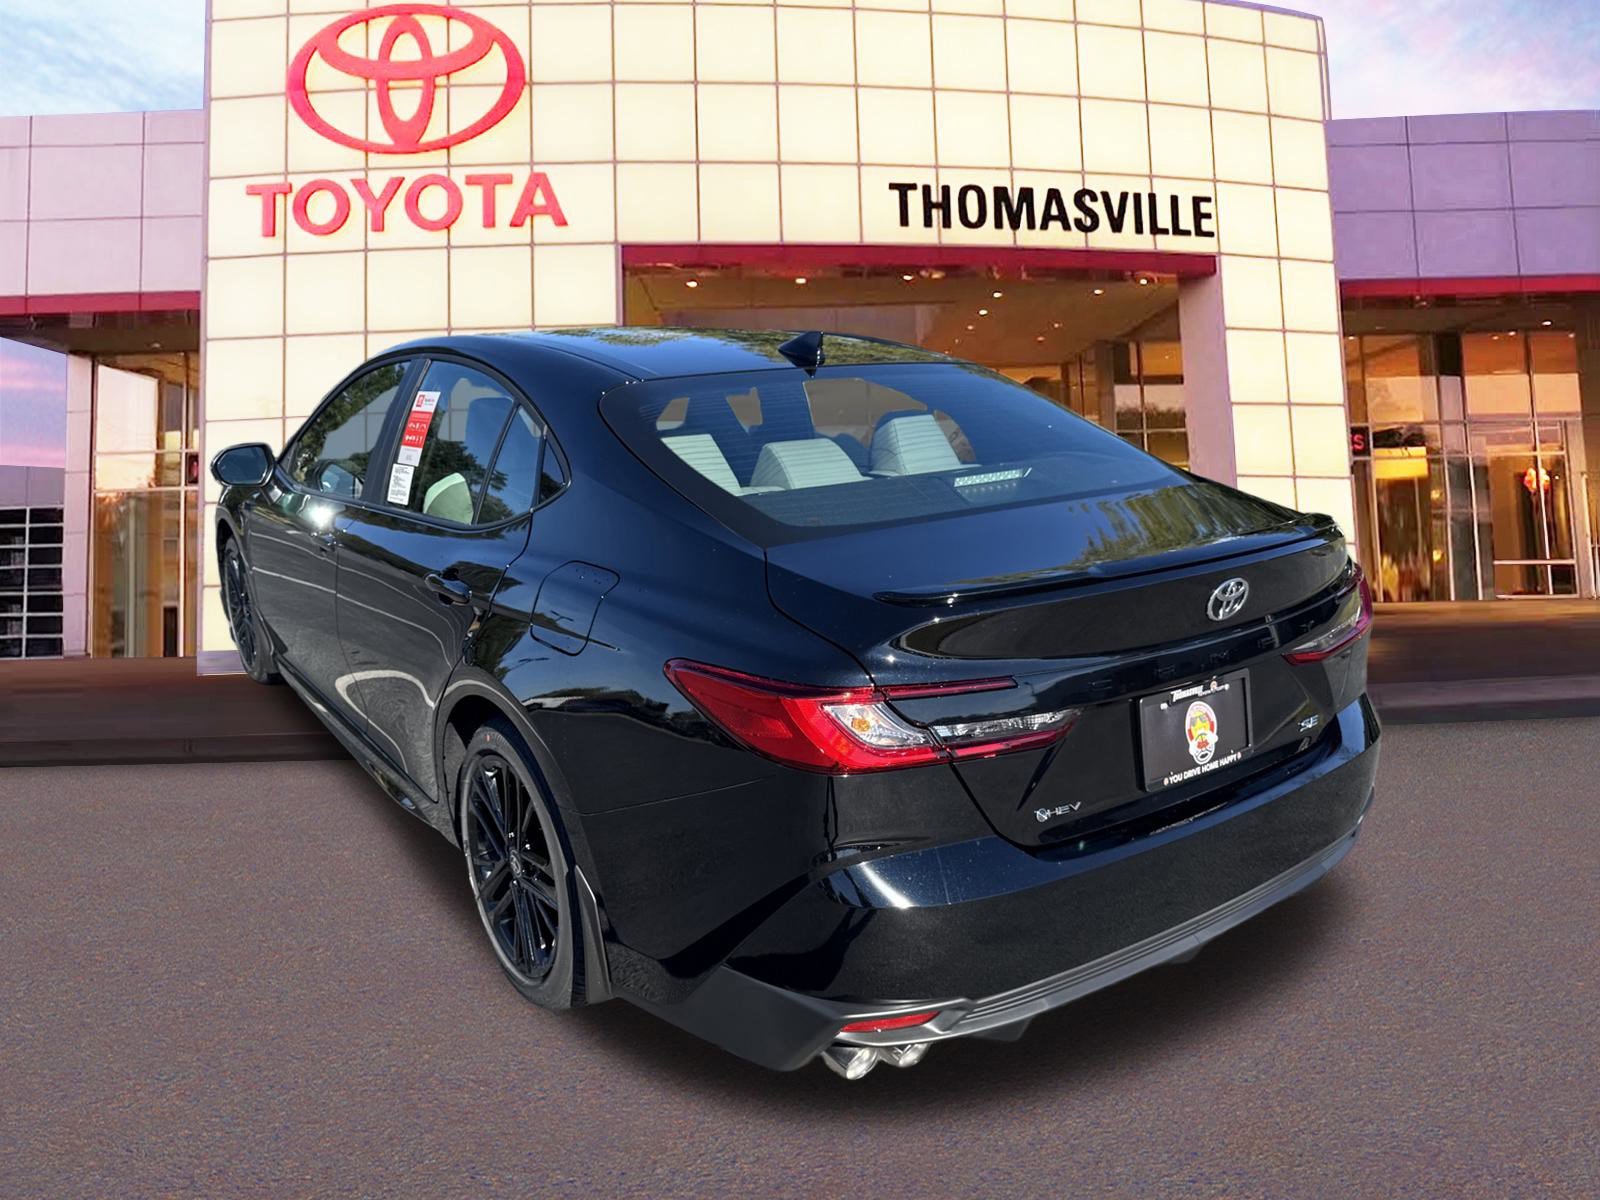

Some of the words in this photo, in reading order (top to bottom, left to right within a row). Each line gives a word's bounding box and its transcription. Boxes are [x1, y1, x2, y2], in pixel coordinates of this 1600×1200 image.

[246, 172, 568, 237] TOYOTA
[889, 183, 1215, 237] THOMASVILLE
[1169, 772, 1183, 784] YOU
[1183, 767, 1201, 780] DRIVE
[1201, 760, 1219, 773] HOME
[1219, 753, 1237, 767] HAPPY
[1046, 801, 1081, 818] HEV
